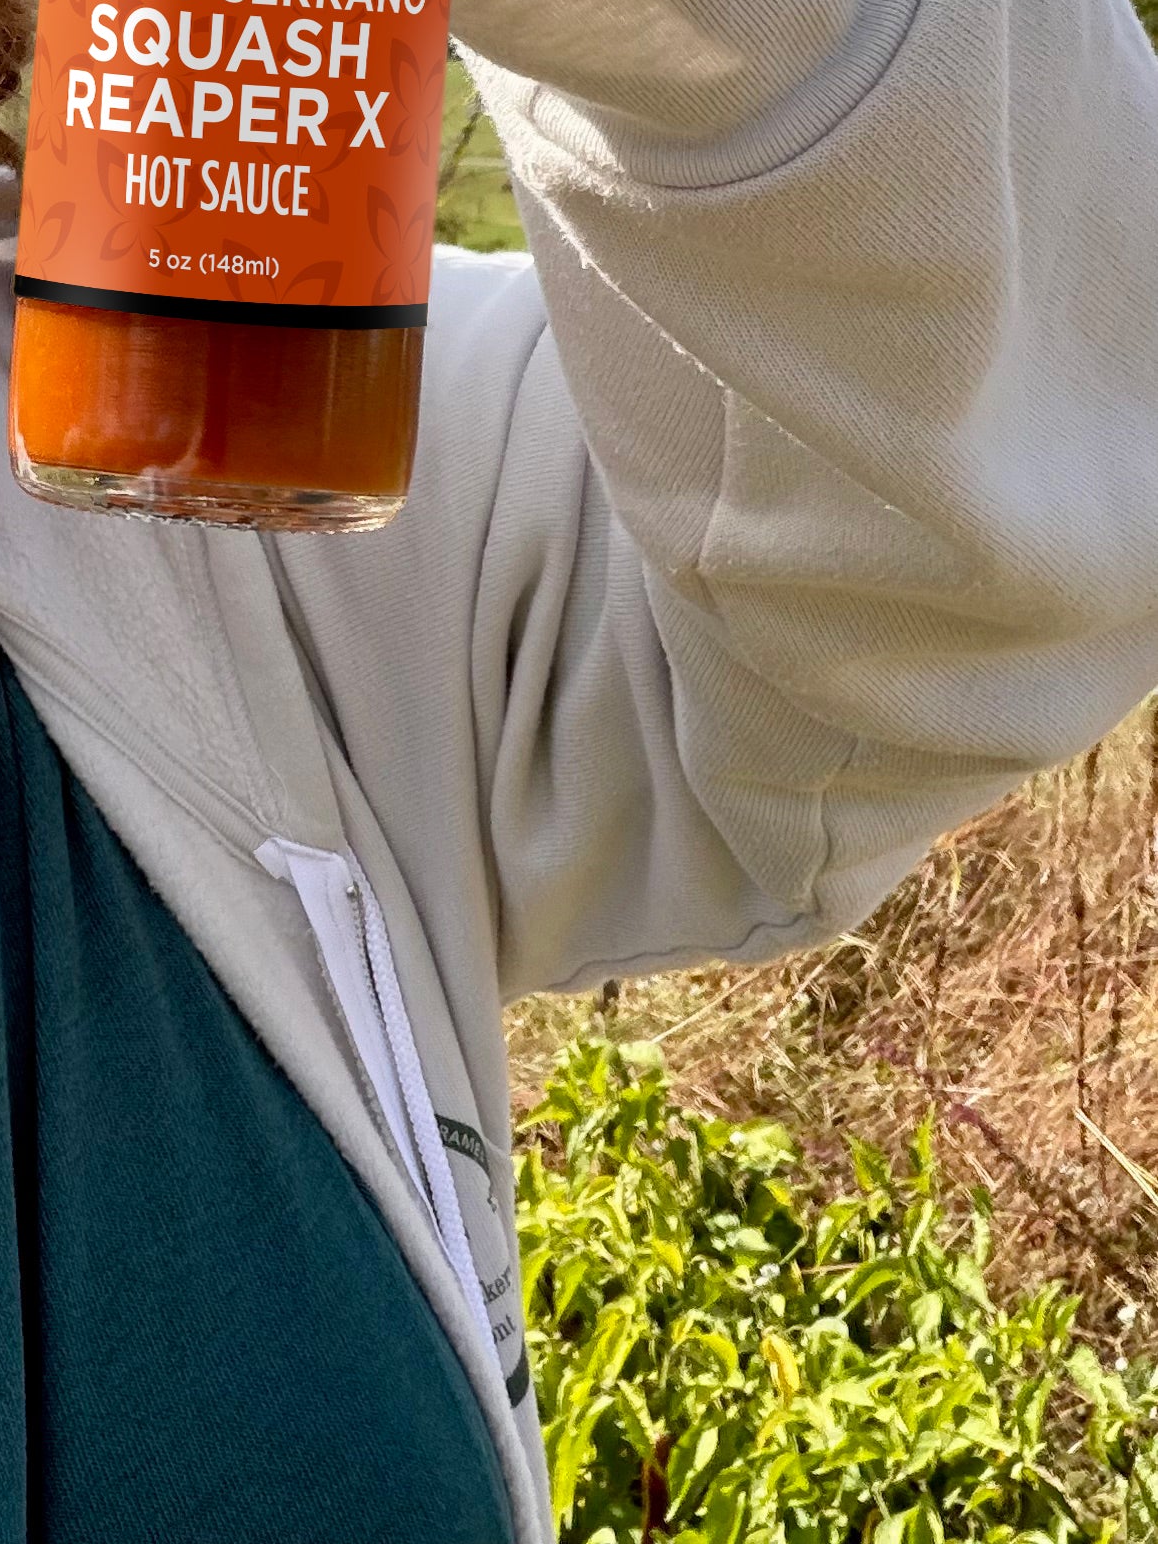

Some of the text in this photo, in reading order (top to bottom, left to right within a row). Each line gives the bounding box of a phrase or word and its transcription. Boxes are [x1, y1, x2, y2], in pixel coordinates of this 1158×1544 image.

[87, 2, 371, 80] SQUASH
[65, 68, 390, 149] REAPER X
[125, 152, 311, 217] HOT SAUCE
[148, 248, 280, 279] 5 oz (148ml)
